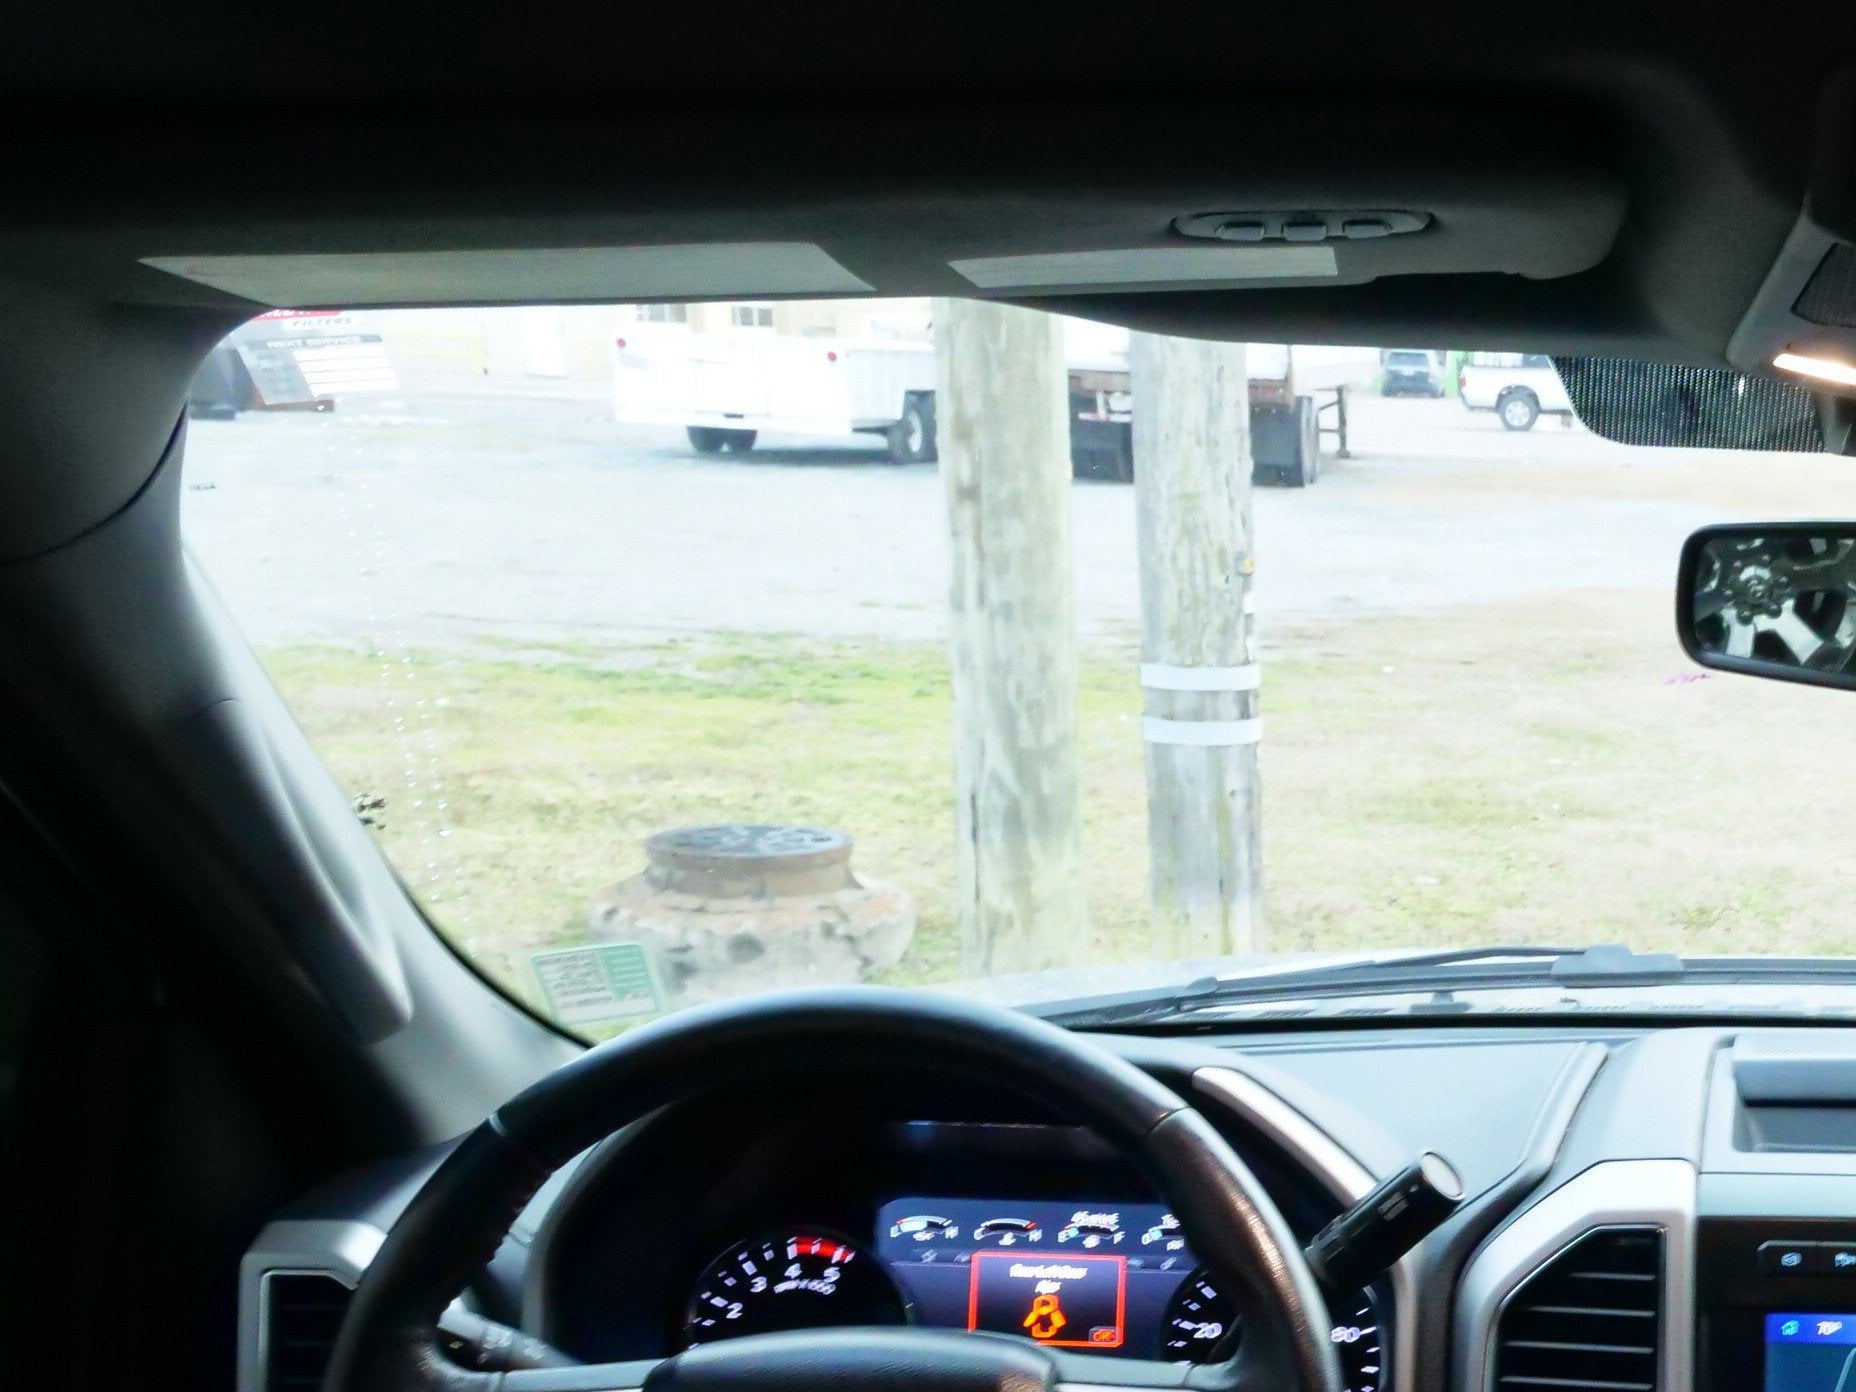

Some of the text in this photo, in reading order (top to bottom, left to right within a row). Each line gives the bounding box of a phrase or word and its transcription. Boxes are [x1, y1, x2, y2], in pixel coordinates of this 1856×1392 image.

[266, 335, 362, 350] NEXT SERVICE
[784, 1263, 802, 1279] 4
[823, 1266, 841, 1283] 5
[750, 1276, 767, 1293] 3
[726, 1302, 743, 1319] 2
[1193, 1322, 1222, 1339] 20
